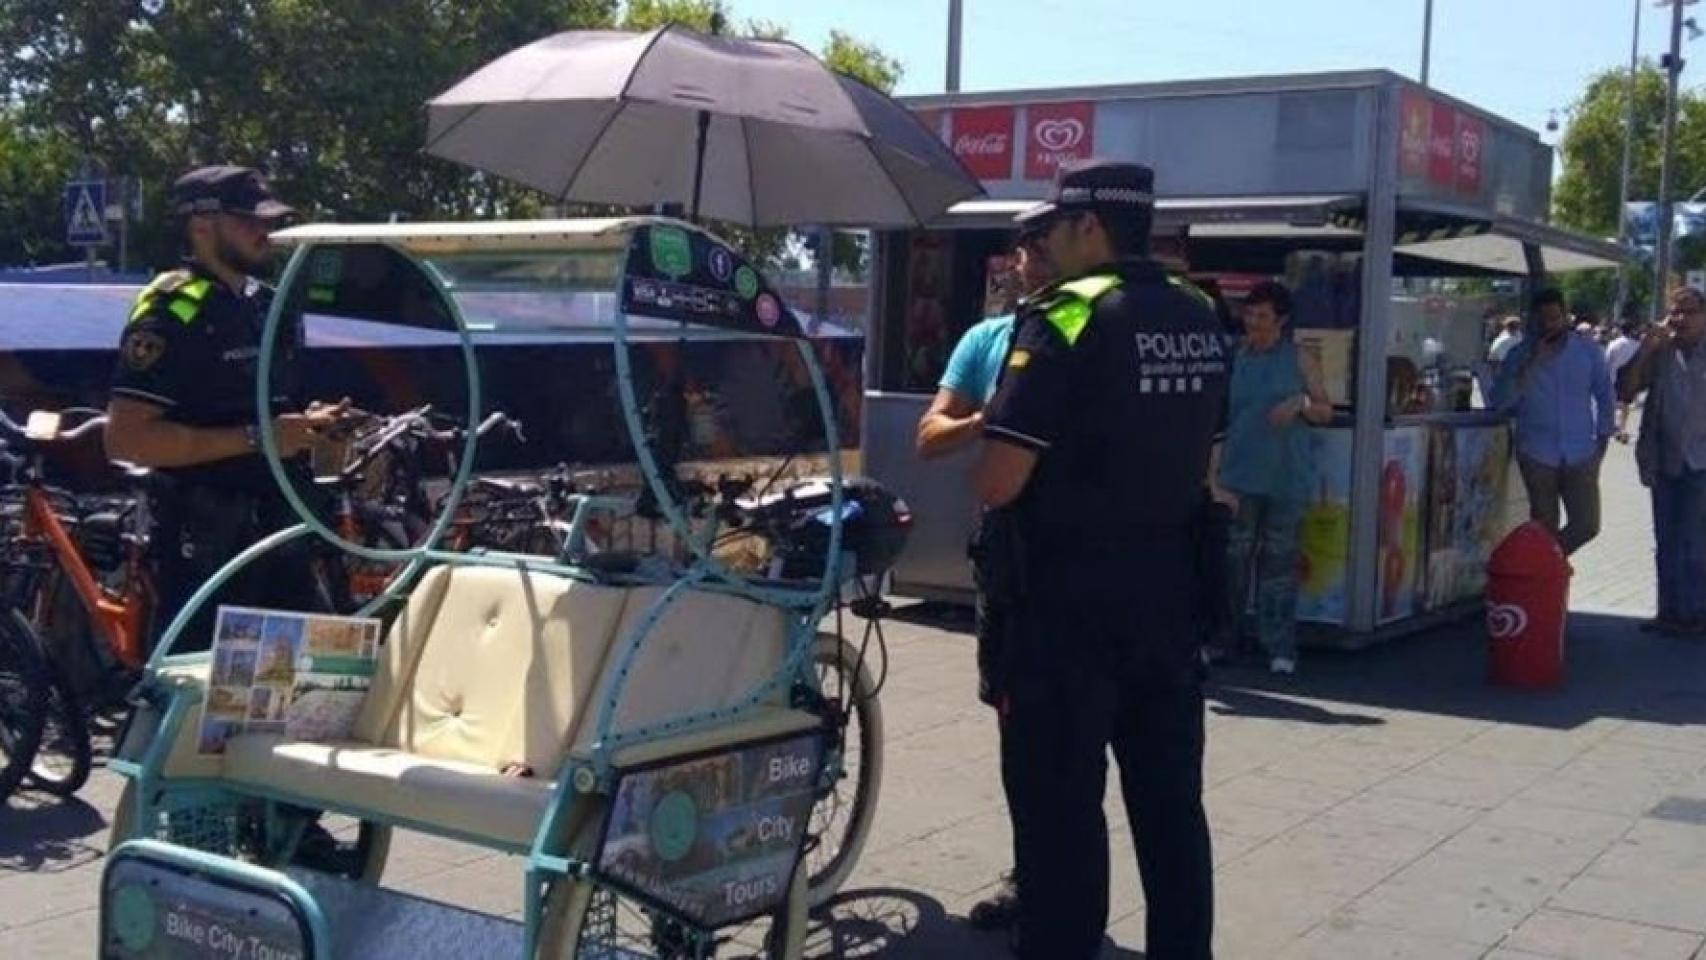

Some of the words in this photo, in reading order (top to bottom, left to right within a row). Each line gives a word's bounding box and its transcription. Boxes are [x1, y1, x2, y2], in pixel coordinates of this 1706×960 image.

[1137, 332, 1222, 358] POLICIA
[769, 756, 810, 782] Bike
[759, 816, 794, 842] City
[725, 876, 776, 905] Tours
[166, 911, 205, 944] Bike
[208, 923, 244, 957] City
